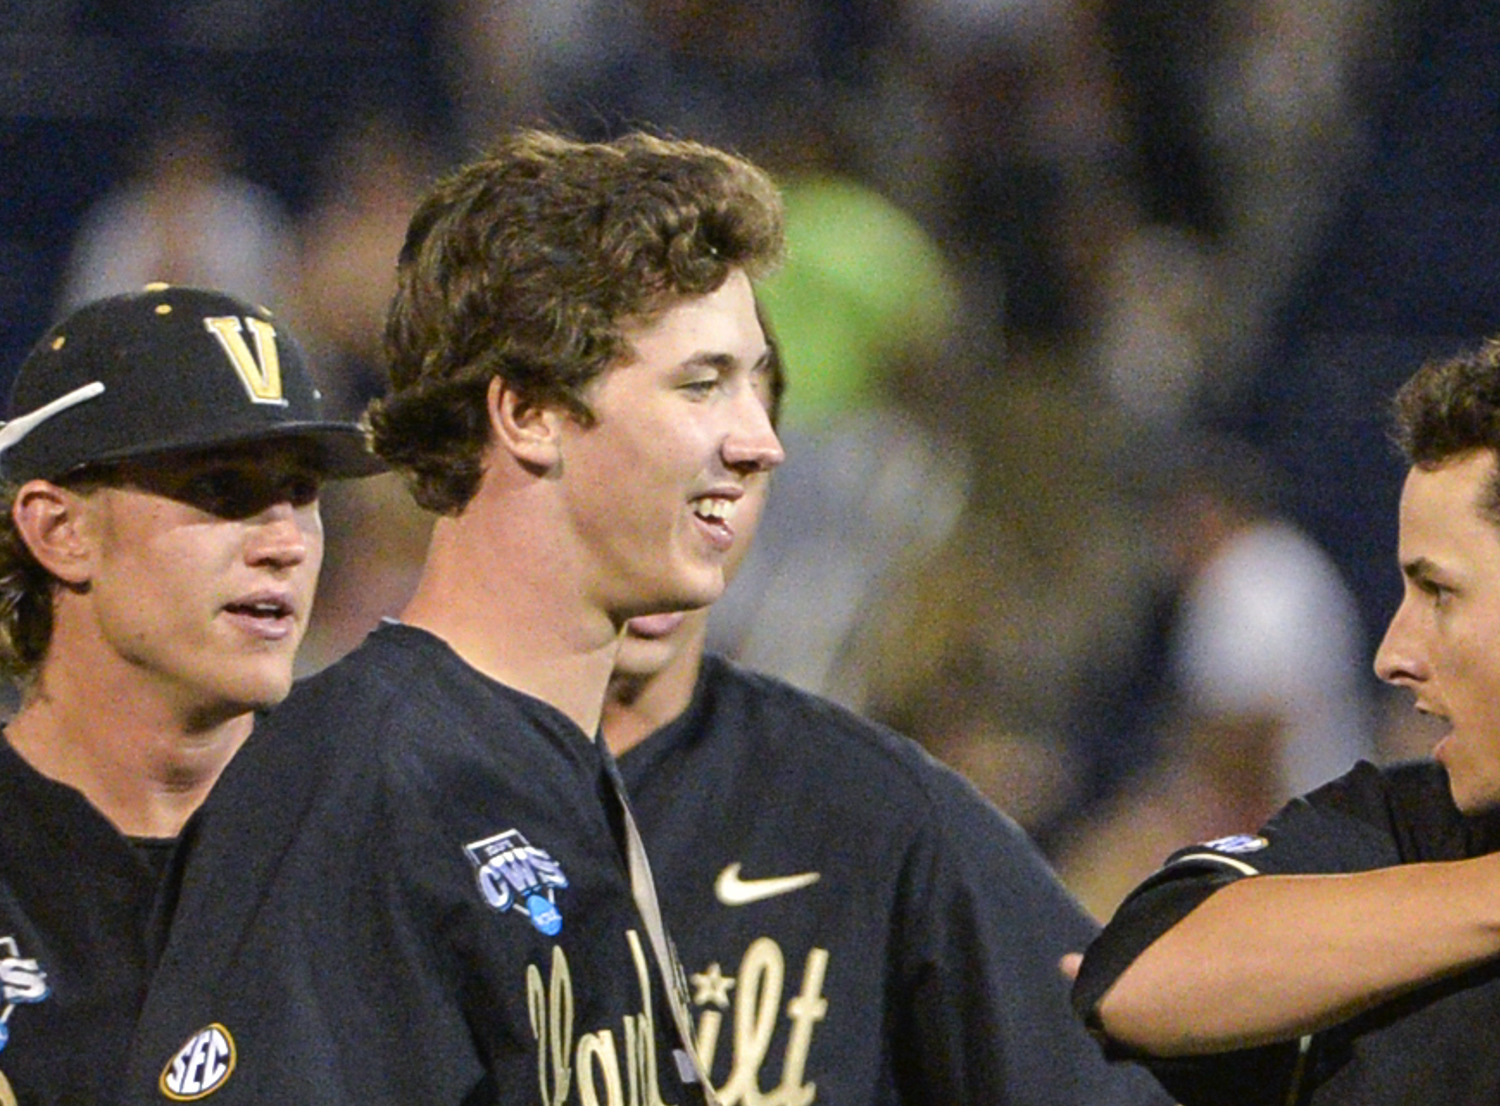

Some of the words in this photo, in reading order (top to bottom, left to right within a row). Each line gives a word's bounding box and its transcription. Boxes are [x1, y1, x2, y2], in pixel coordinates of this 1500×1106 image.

[203, 316, 289, 407] V
[479, 846, 569, 912] CWS
[165, 1028, 229, 1095] SEC
